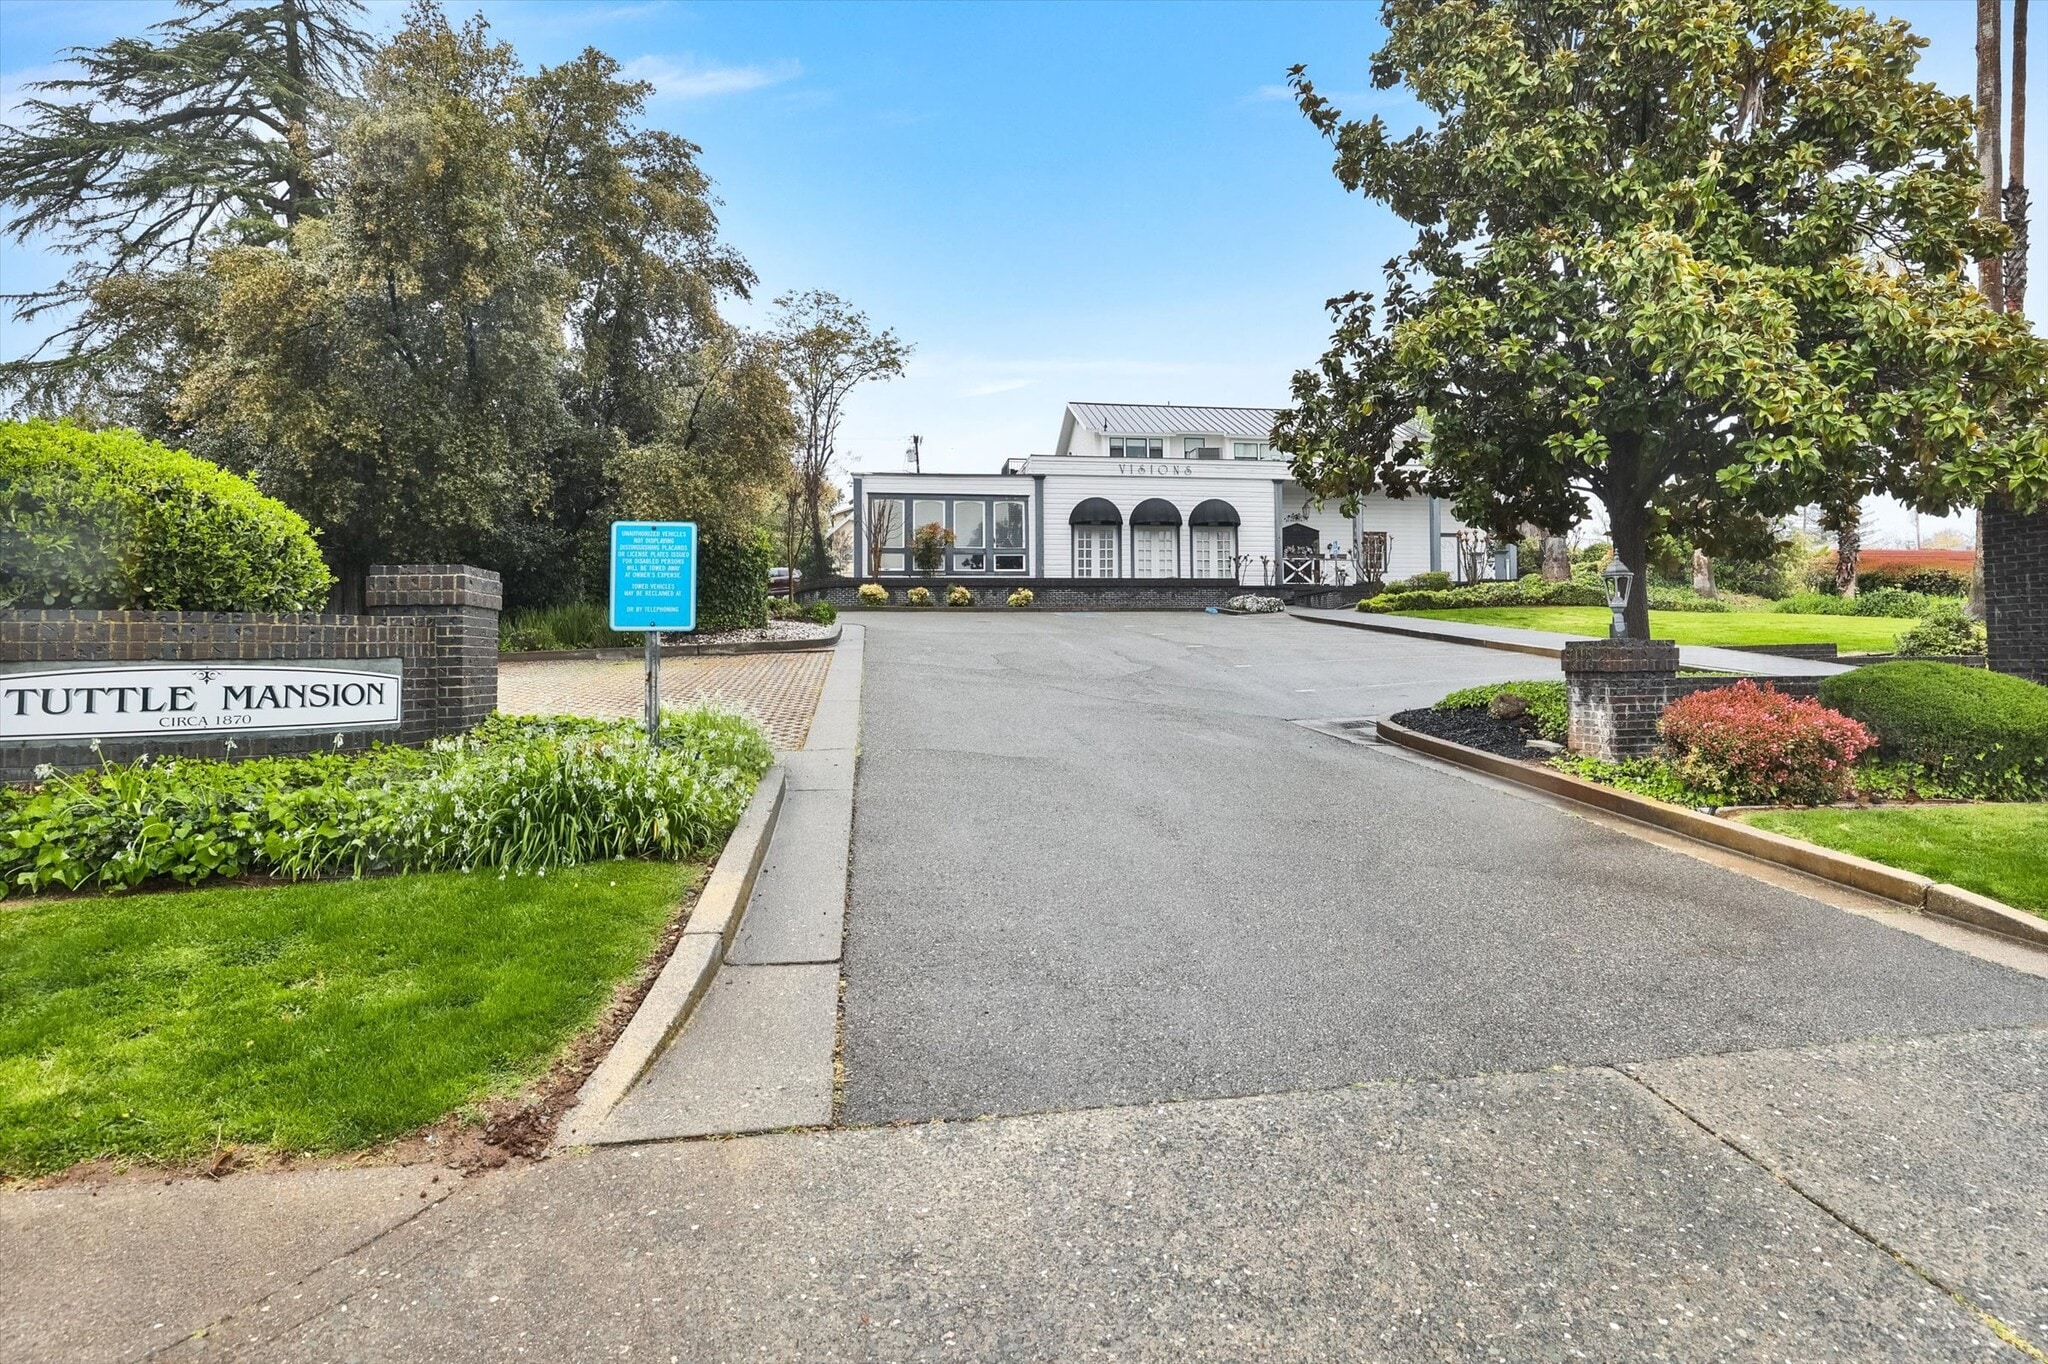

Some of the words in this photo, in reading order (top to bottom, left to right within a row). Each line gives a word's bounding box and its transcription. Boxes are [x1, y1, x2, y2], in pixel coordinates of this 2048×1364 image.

[1118, 464, 1192, 475] VISIONS
[5, 685, 198, 716] TUTTLE
[223, 682, 385, 710] MANSION
[159, 715, 209, 728] CIRCA
[215, 714, 252, 725] 1870
